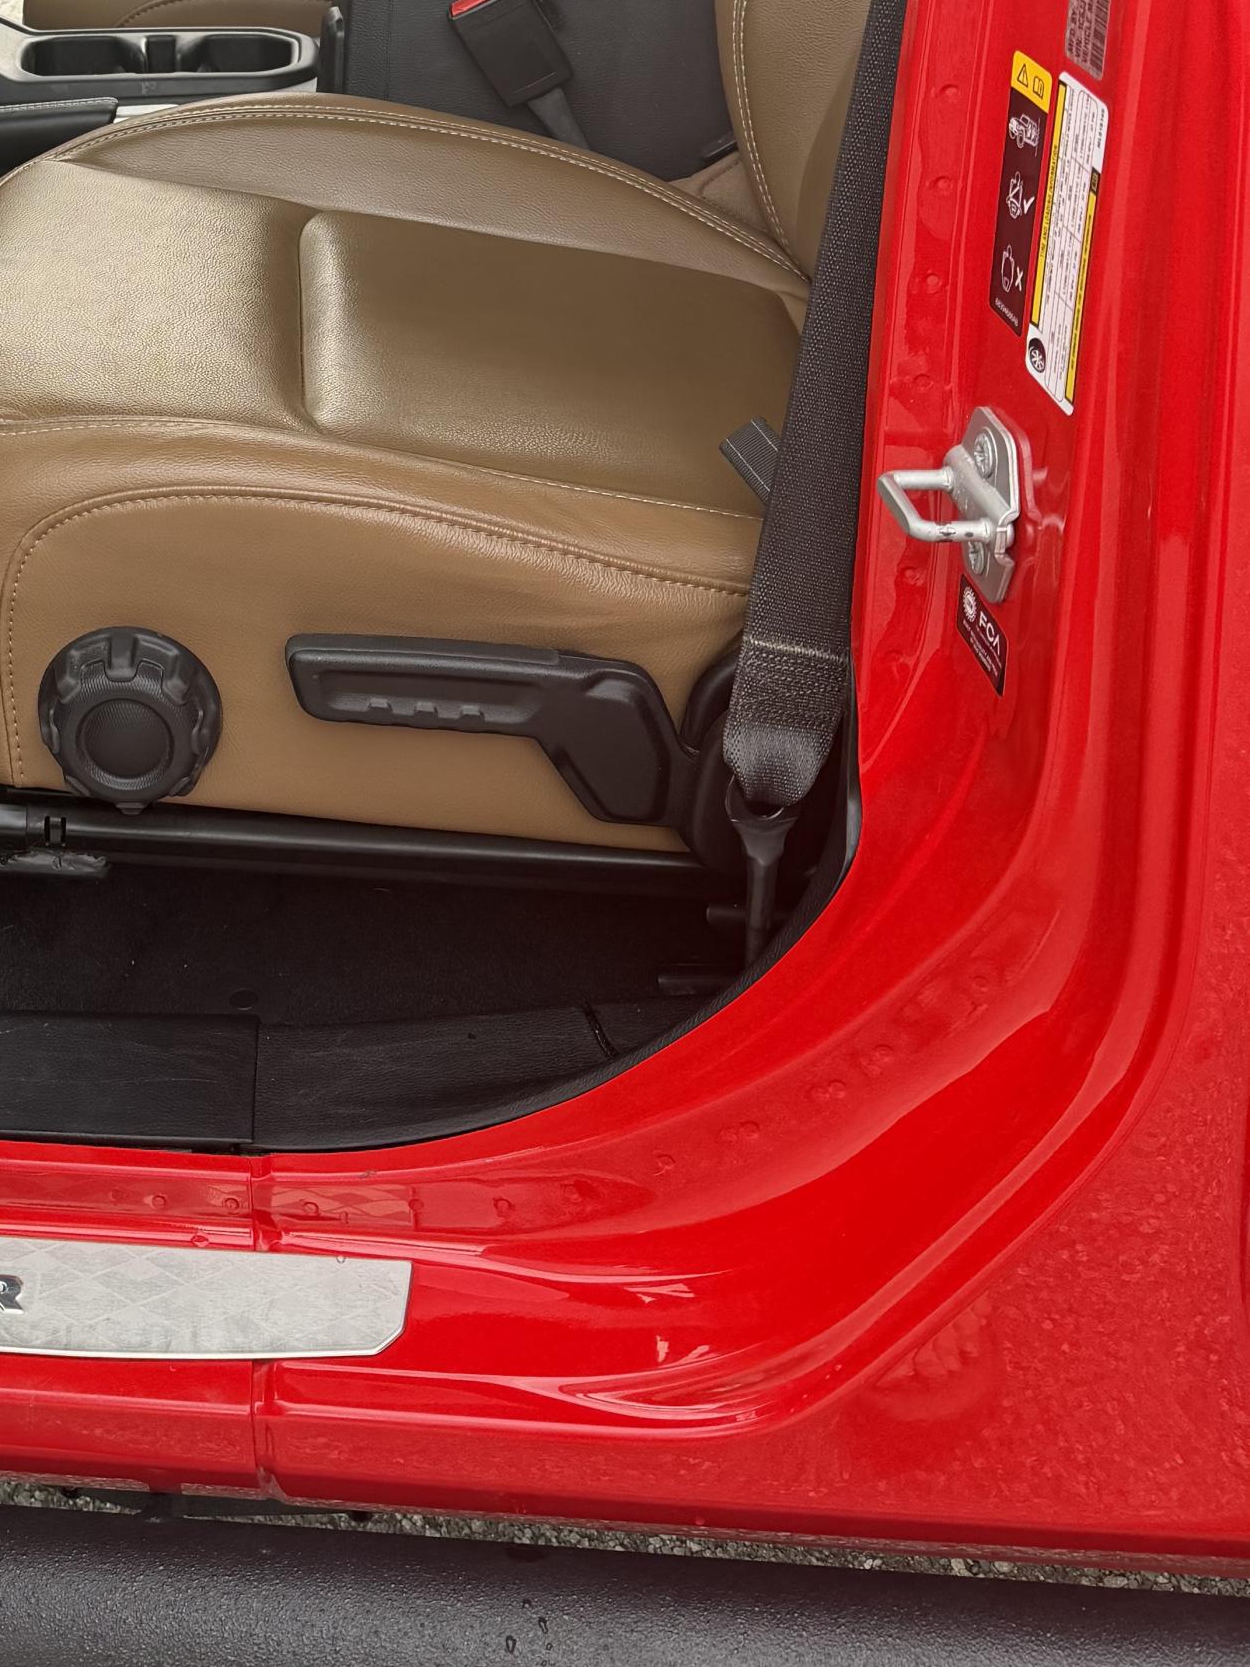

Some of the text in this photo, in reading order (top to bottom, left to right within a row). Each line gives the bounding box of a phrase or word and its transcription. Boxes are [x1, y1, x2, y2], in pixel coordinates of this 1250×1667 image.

[1068, 29, 1076, 54] MFD
[1082, 17, 1092, 62] VEHICLE
[1048, 144, 1058, 193] INFORMATION
[1044, 193, 1053, 225] LOADING
[979, 611, 1000, 656] FCA
